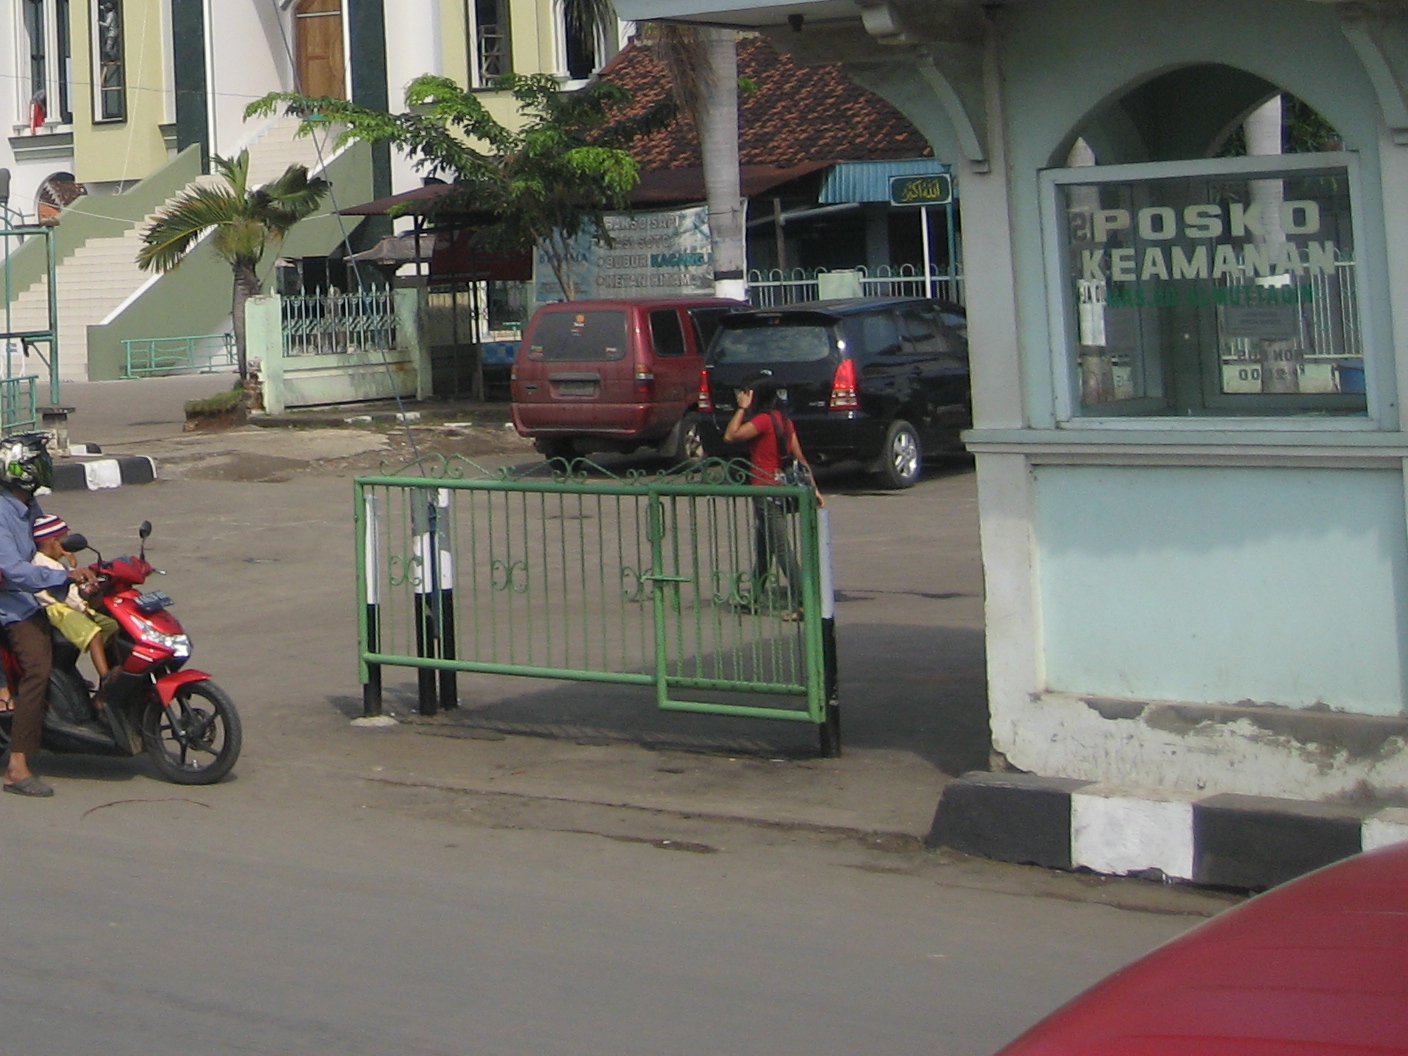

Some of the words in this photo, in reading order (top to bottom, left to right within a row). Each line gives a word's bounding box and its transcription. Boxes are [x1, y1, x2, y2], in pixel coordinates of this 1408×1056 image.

[652, 215, 679, 230] SAPI
[1093, 199, 1321, 243] POSKO
[605, 255, 649, 269] BUBUR
[650, 253, 704, 268] KACANG
[1080, 240, 1335, 282] KEAMANAN
